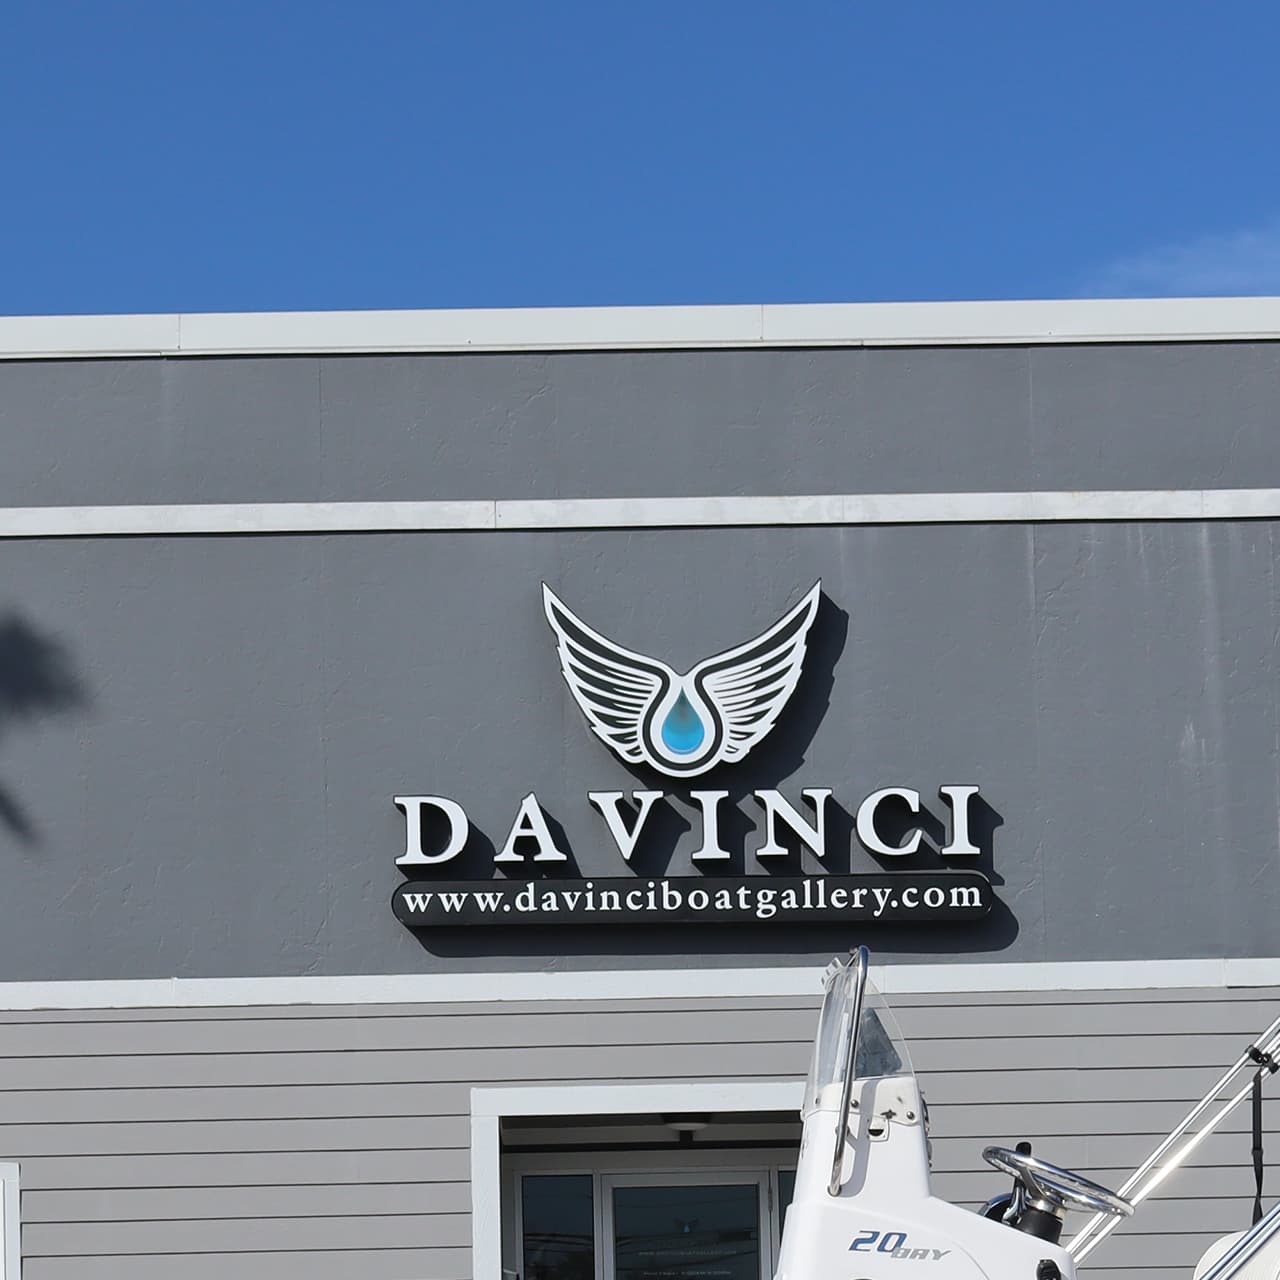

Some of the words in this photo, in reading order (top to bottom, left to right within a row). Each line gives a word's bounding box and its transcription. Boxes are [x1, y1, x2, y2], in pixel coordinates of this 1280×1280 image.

[393, 785, 981, 866] DAVINCI
[401, 880, 983, 919] www.davinciboatgallery.com
[848, 1230, 907, 1253] 20
